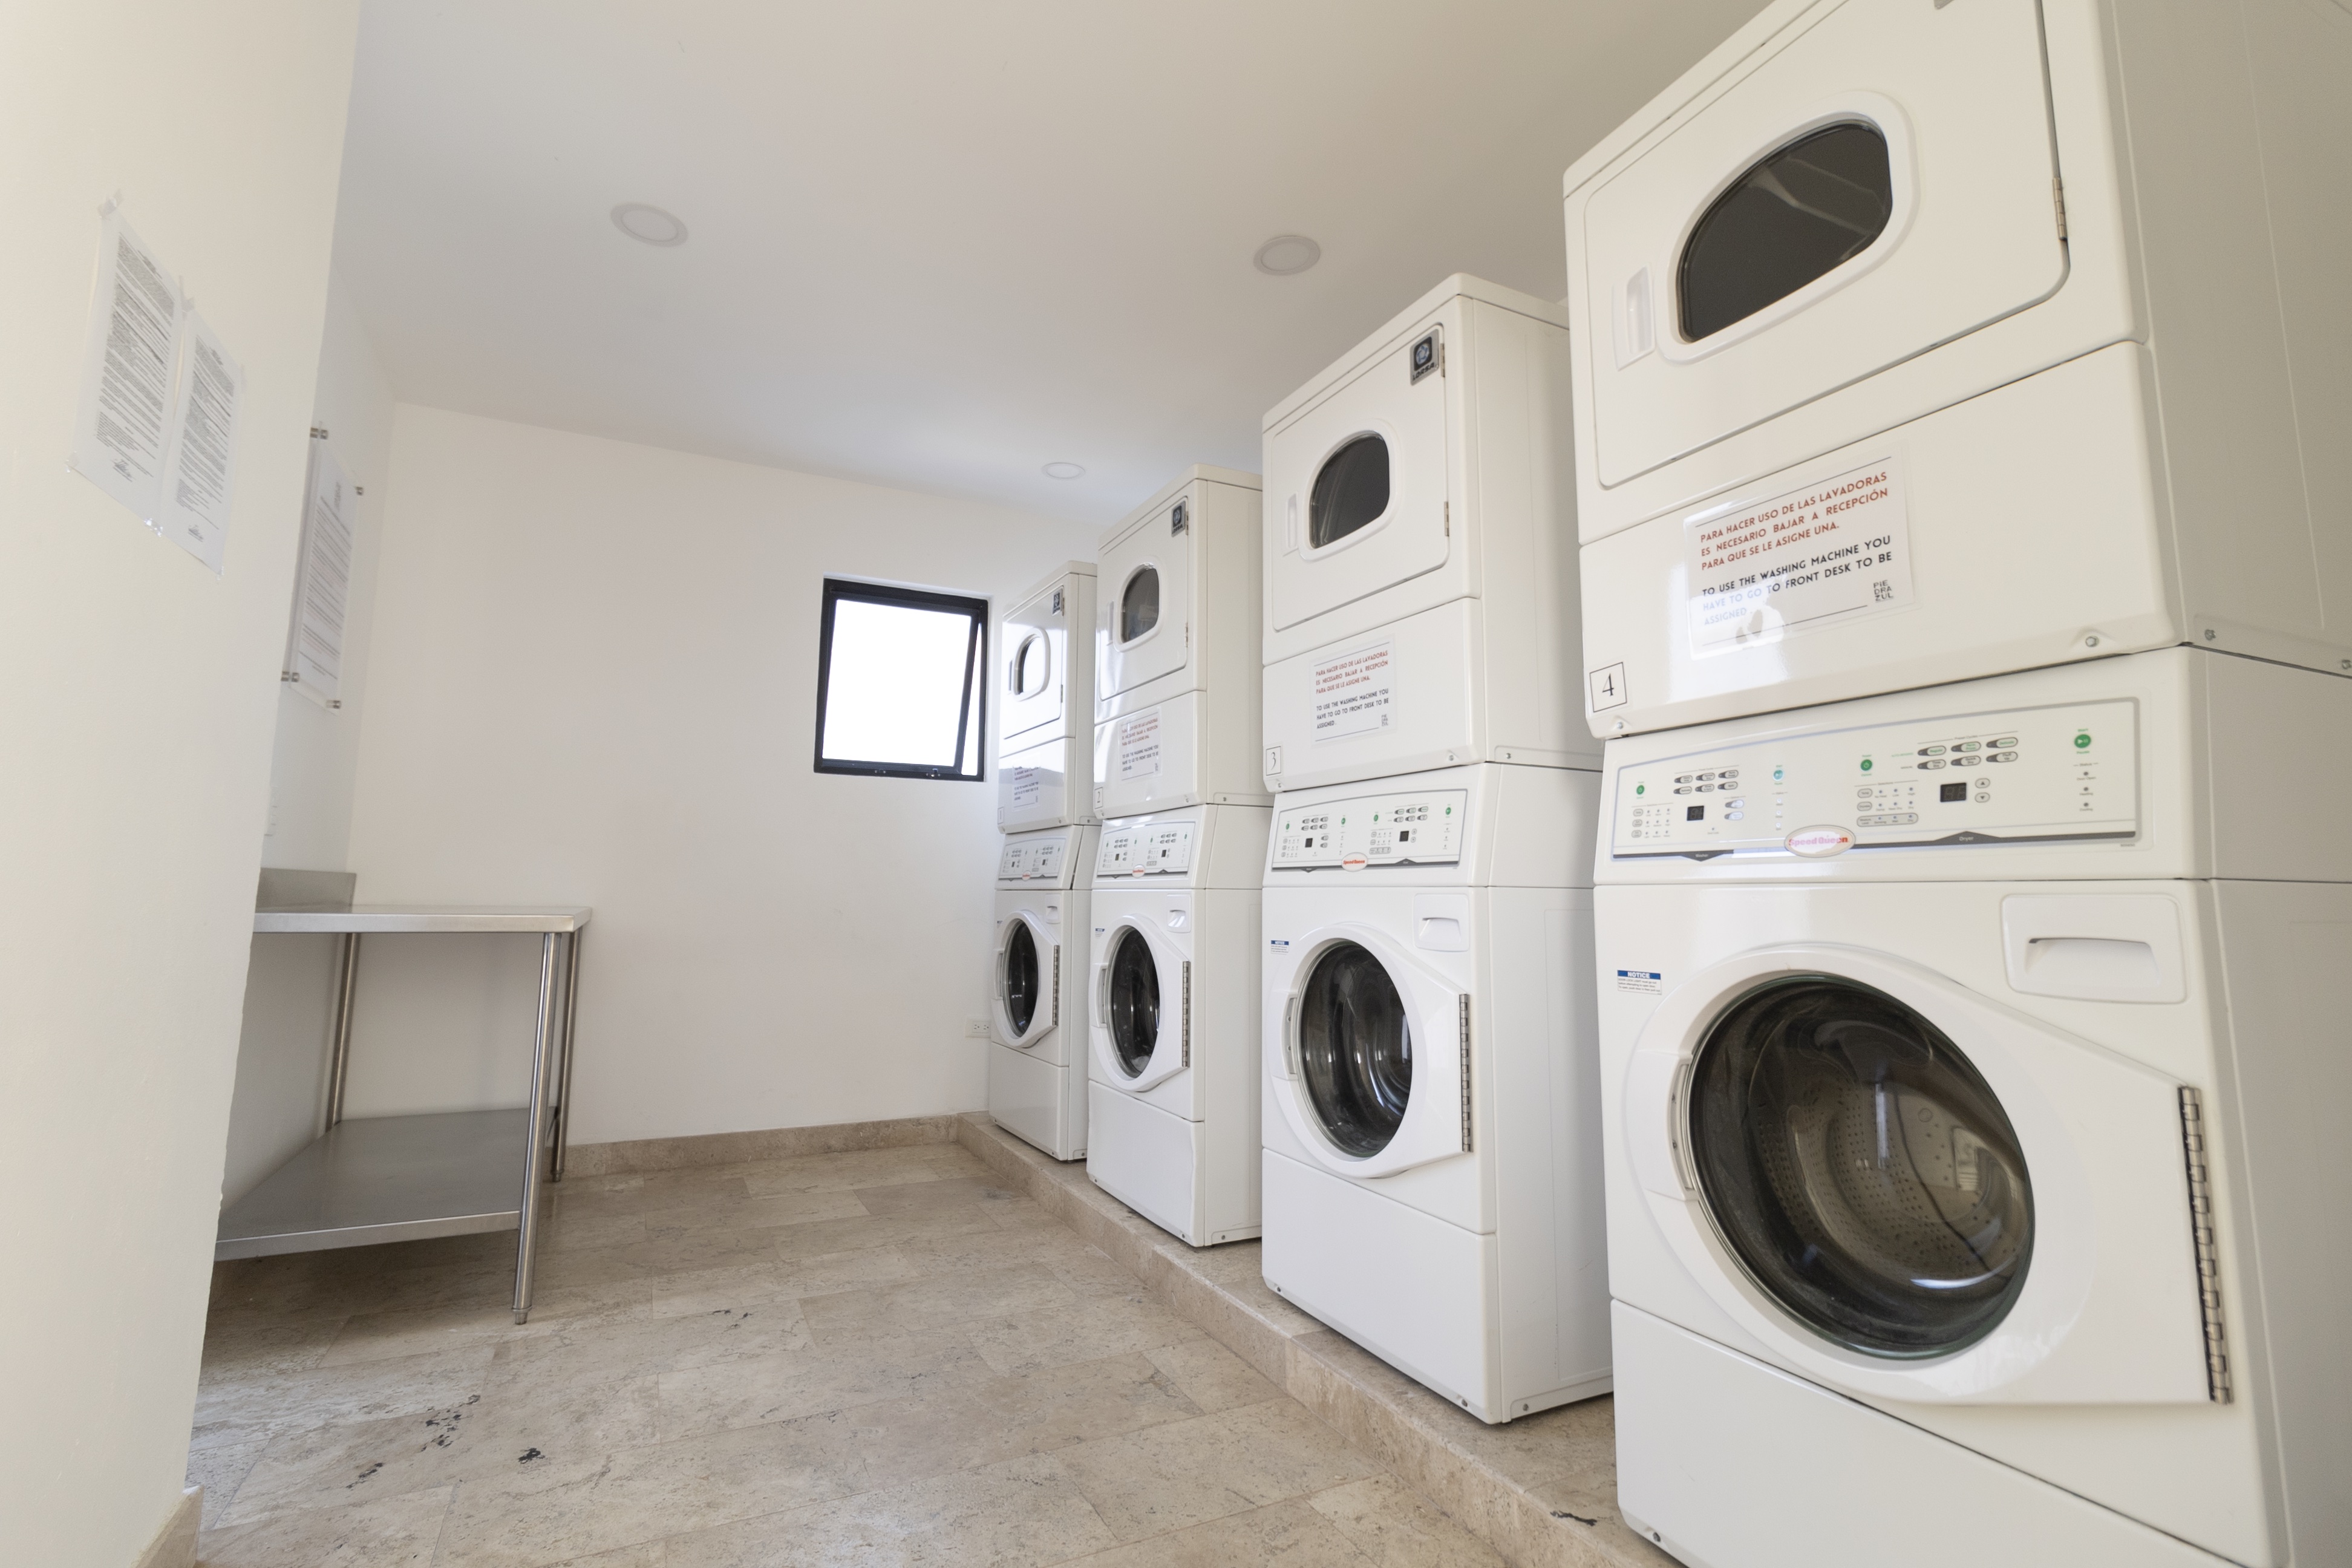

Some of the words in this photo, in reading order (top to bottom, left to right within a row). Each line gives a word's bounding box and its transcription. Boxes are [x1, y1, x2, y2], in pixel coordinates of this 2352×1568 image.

[1700, 529, 1723, 543] PARA
[1726, 517, 1755, 534] HACER
[1758, 509, 1778, 522] USO
[1782, 504, 1794, 514] DE
[1798, 497, 1815, 509] LAS
[1819, 472, 1887, 502] LAVADORAS
[1701, 547, 1710, 557] ES
[1717, 529, 1766, 551] NECESARIO
[1774, 516, 1805, 532] BAJAR
[1812, 512, 1818, 520] A
[1826, 488, 1888, 515] RECEPCIÓN
[1702, 558, 1724, 570] PARA
[1728, 550, 1746, 561] QUE
[1749, 546, 1759, 555] SE
[1763, 541, 1772, 551] LE
[1775, 529, 1811, 547] ASIGNE
[1815, 521, 1839, 535] UNA.
[1702, 587, 1714, 596] TO
[1719, 581, 1735, 592] USE
[1739, 575, 1756, 586] THE
[1760, 560, 1806, 580] WASHING
[1811, 544, 1859, 566] MACHINE
[1864, 535, 1890, 550] YOU
[1704, 598, 1725, 611] HAVE
[1730, 593, 1742, 603] TO
[1747, 589, 1762, 598] GO
[1766, 583, 1780, 593] TO
[1786, 572, 1819, 589] FRONT
[1824, 563, 1851, 578] DESK
[1856, 558, 1872, 569] TO
[1878, 552, 1892, 563] BE
[1874, 586, 1892, 595] DRA
[1875, 592, 1893, 601] ZUL
[1362, 650, 1388, 662] LAVADORAS
[1322, 673, 1342, 684] NECESARIO
[1345, 678, 1359, 686] ASIGNE
[1602, 673, 1614, 696] 4
[1339, 696, 1357, 705] WASHING
[1359, 691, 1377, 701] MACHINE
[1271, 752, 1276, 770] 3
[1789, 837, 1817, 846] Speed
